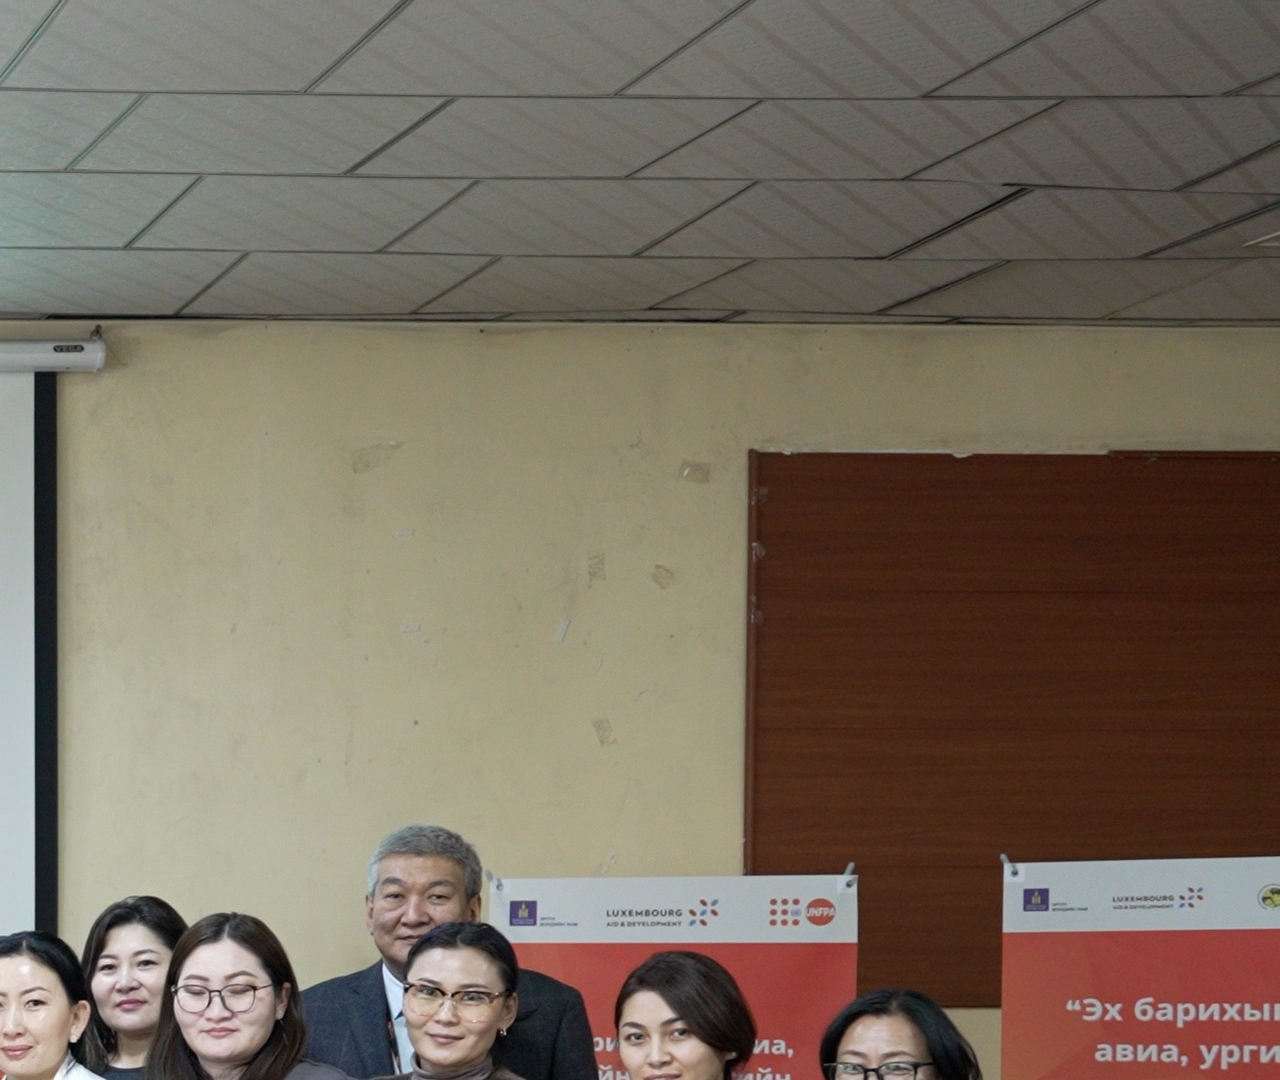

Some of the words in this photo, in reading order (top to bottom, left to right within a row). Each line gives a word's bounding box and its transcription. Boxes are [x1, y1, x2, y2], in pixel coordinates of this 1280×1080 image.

[1112, 895, 1175, 903] LUXEMBOURG
[606, 909, 683, 917] LUXEMBOURG
[805, 906, 836, 918] UNFPA
[1094, 1043, 1189, 1067] авиа,
